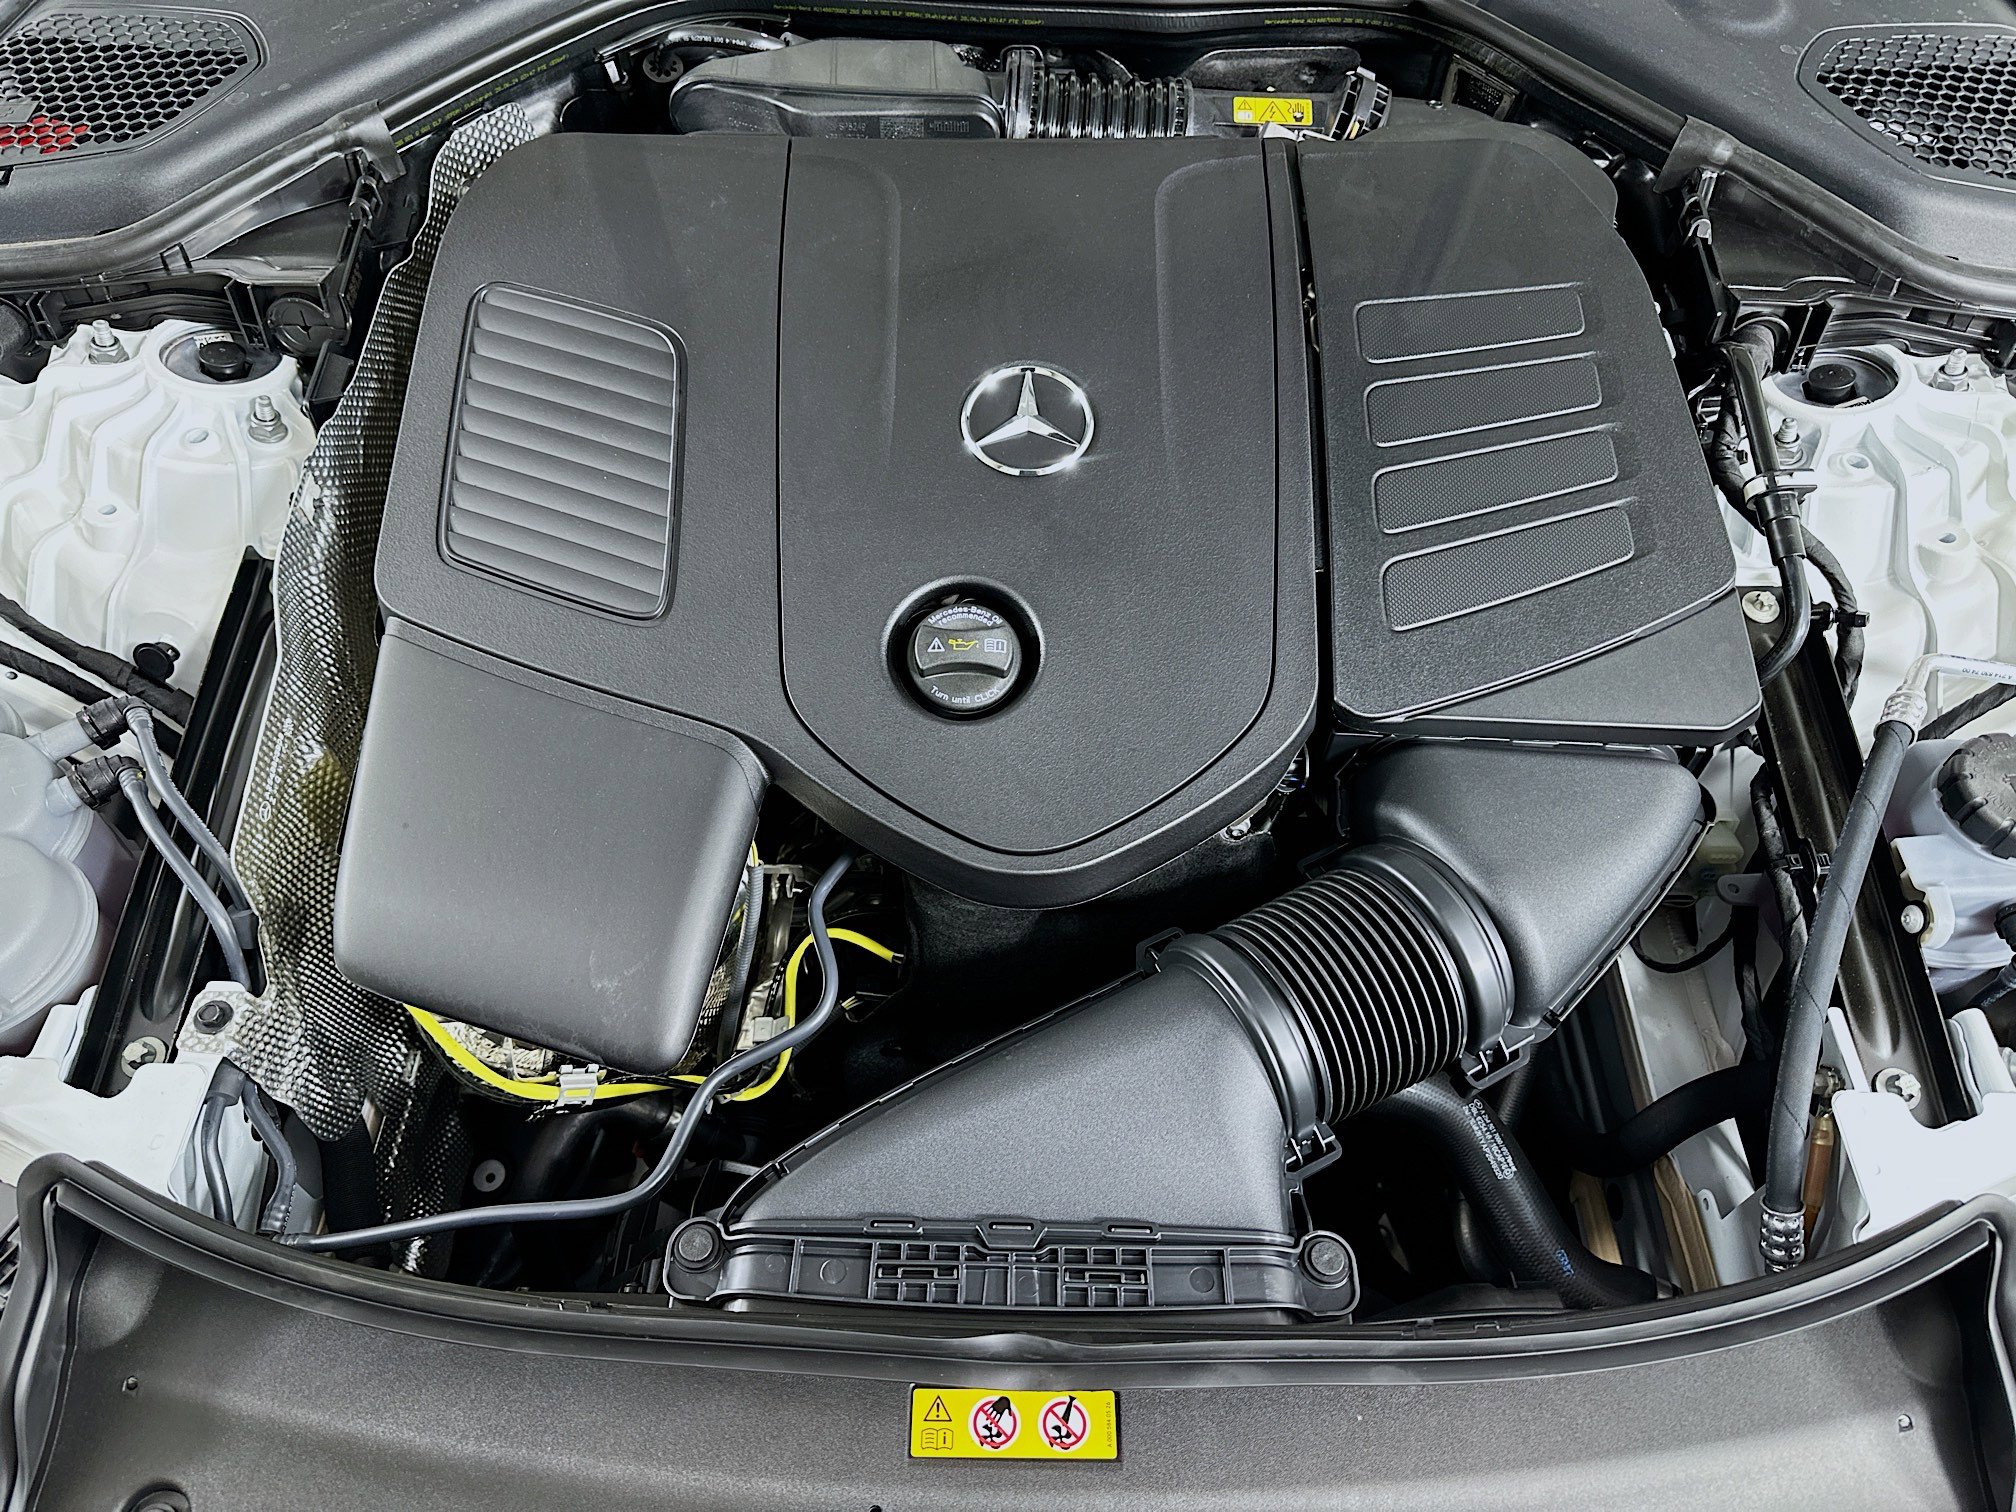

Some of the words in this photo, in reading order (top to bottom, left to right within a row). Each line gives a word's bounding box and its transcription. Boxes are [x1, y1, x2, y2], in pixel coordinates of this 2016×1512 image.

[928, 606, 992, 625] Mercedes-Benz
[992, 615, 1004, 625] Oil
[938, 613, 994, 627] recommended
[930, 686, 949, 701] Turn
[952, 695, 971, 704] until
[974, 688, 1001, 702] CLICK
[1105, 1401, 1111, 1409] 26
